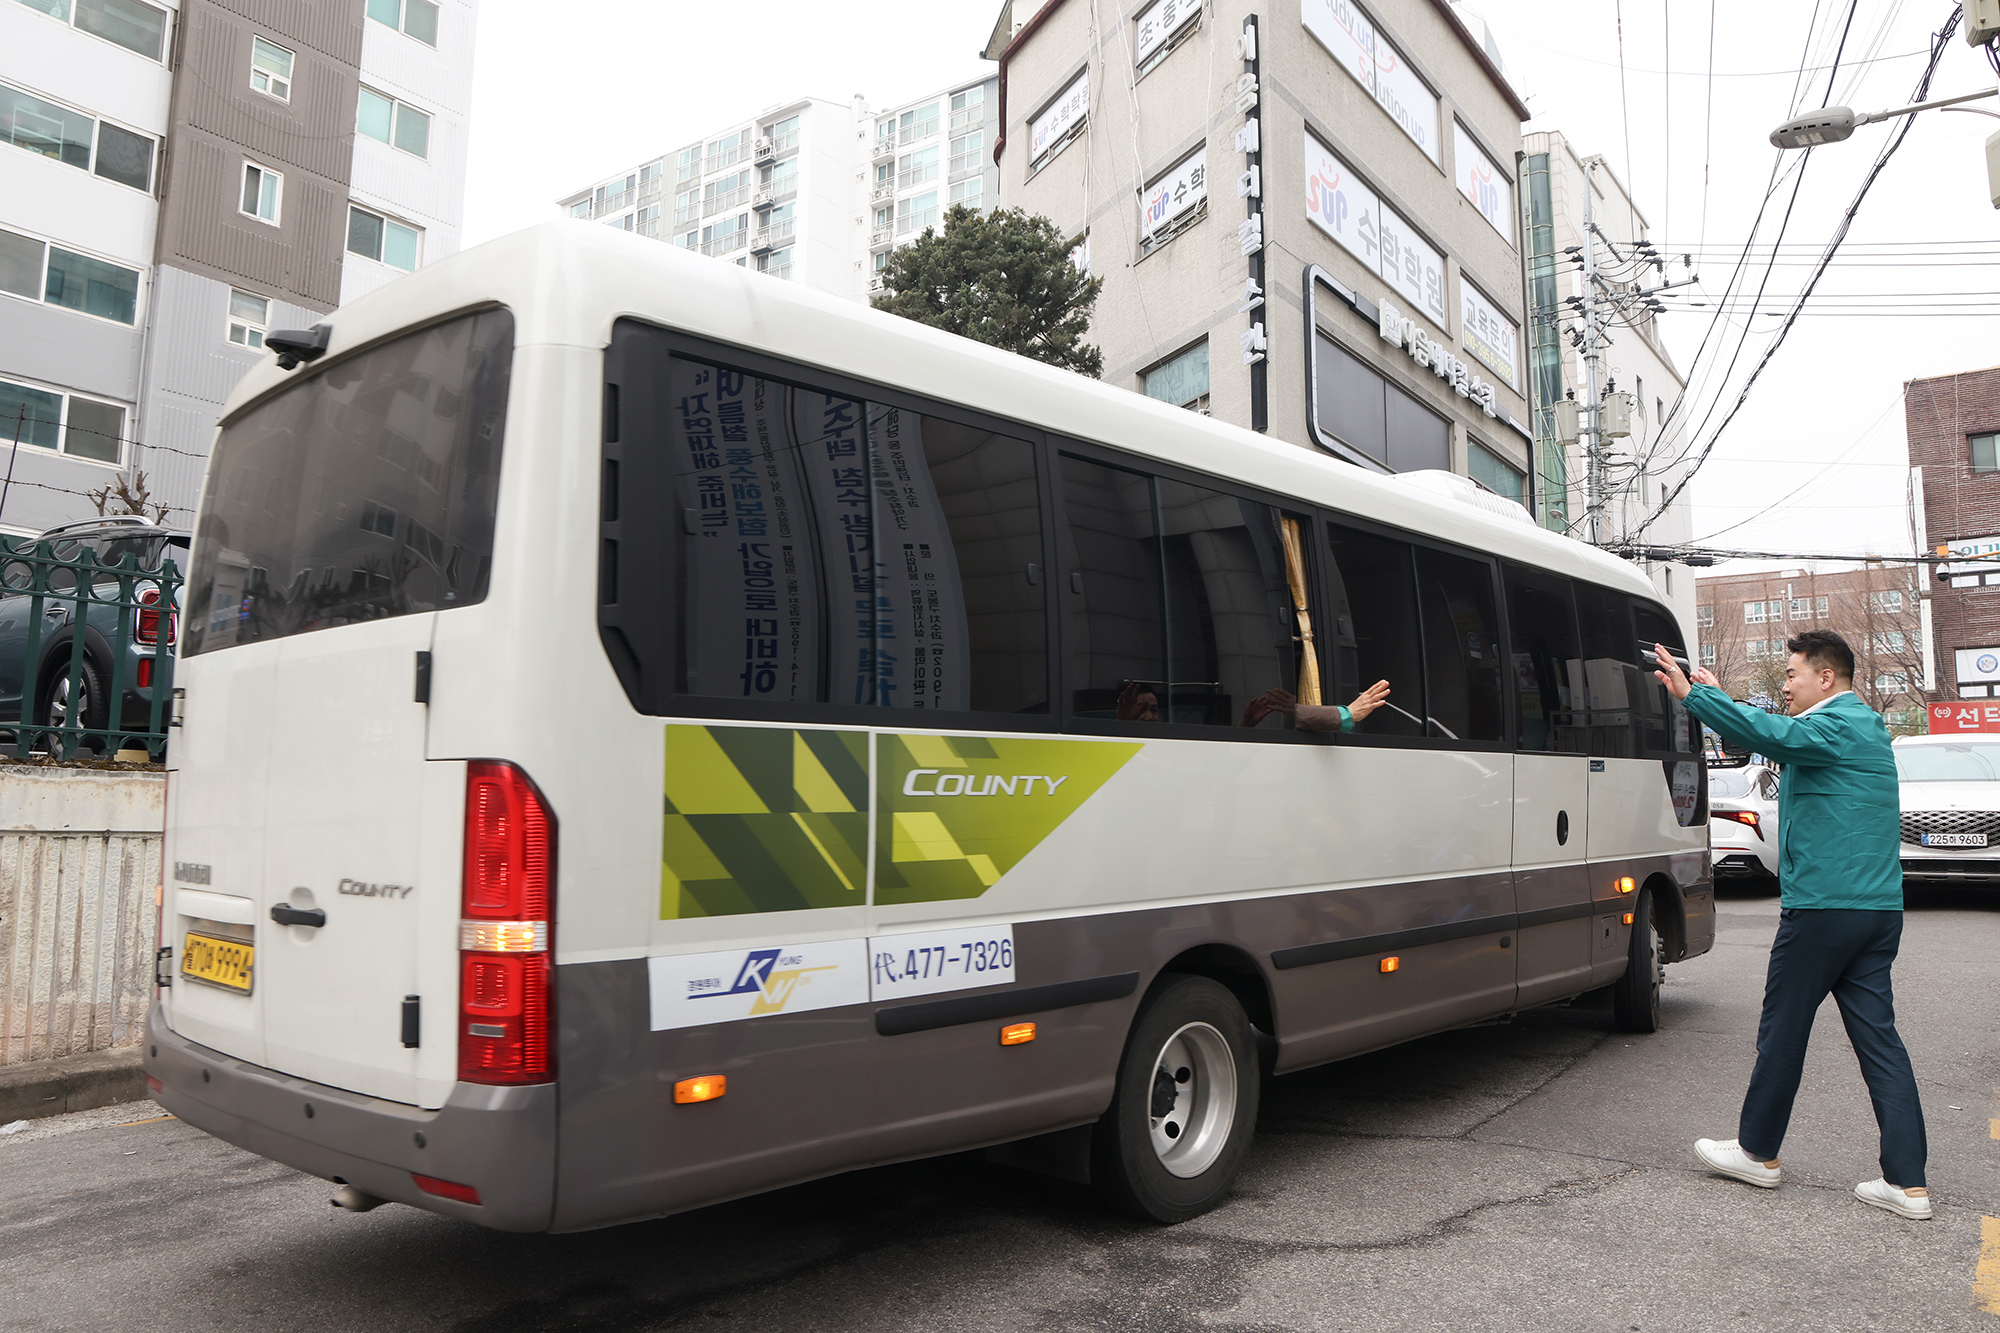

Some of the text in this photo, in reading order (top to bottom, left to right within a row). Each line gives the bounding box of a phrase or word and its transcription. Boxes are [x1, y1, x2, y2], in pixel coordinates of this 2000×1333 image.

[1411, 118, 1425, 146] up
[1233, 24, 1267, 365] 이음메디컬 스킨
[1358, 208, 1444, 319] 수학학원
[1401, 317, 1469, 398] 이음메디컬
[1466, 297, 1511, 361] 교육문의
